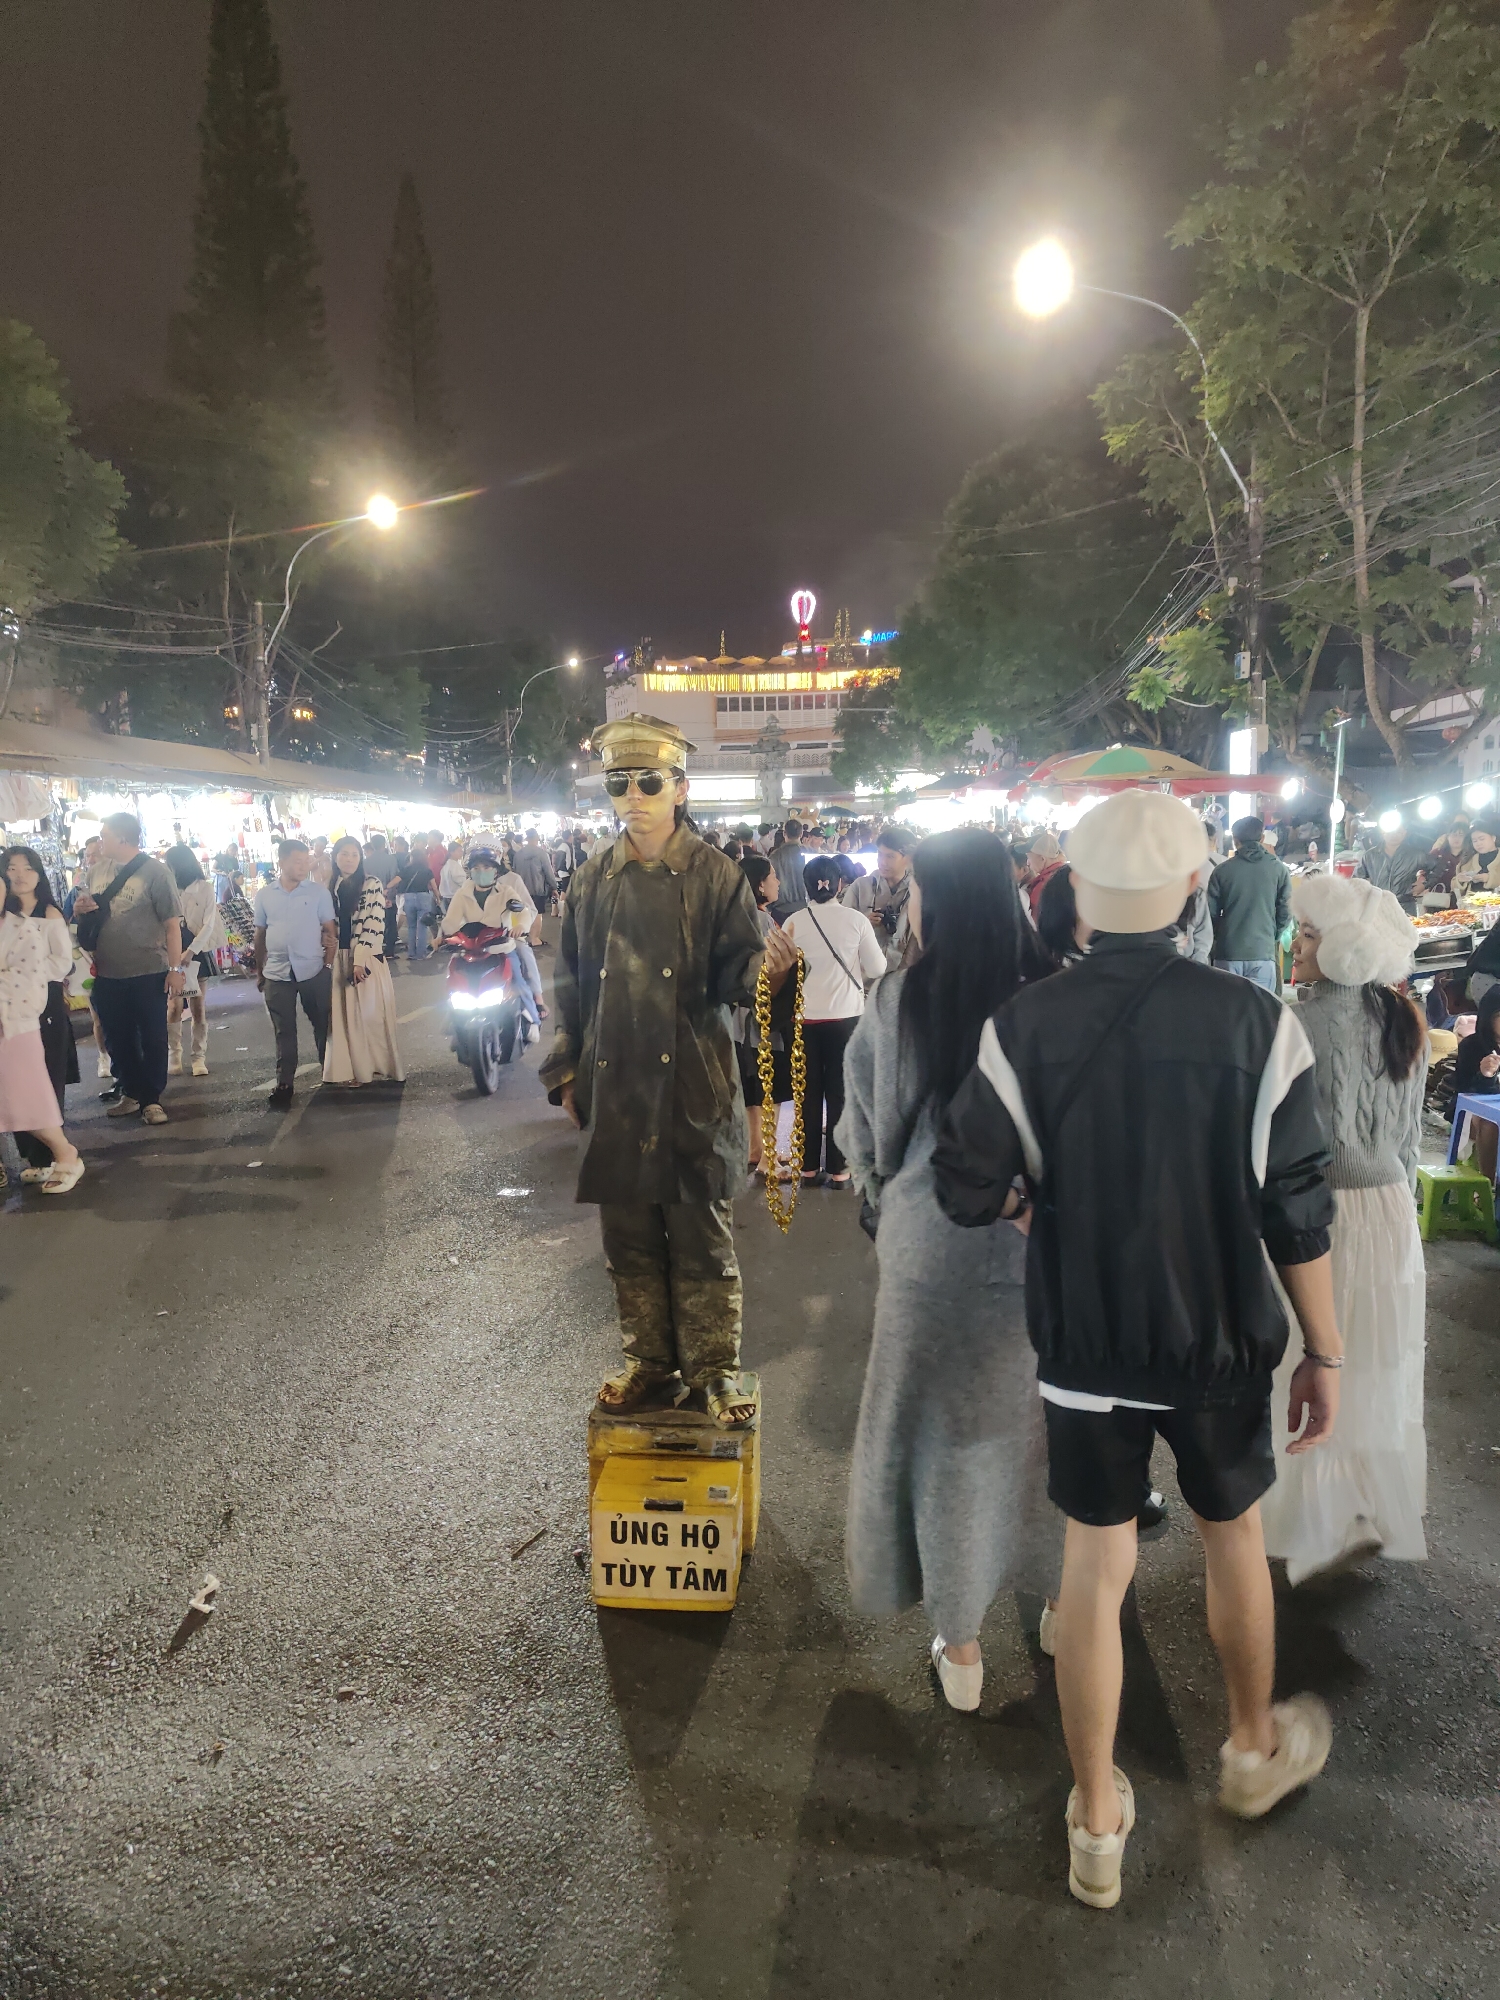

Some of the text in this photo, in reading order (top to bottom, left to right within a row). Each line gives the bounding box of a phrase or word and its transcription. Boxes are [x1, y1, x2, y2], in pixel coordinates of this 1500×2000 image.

[610, 1513, 720, 1555] ỦNG HỘ
[601, 1558, 727, 1592] TÙY TÂM
